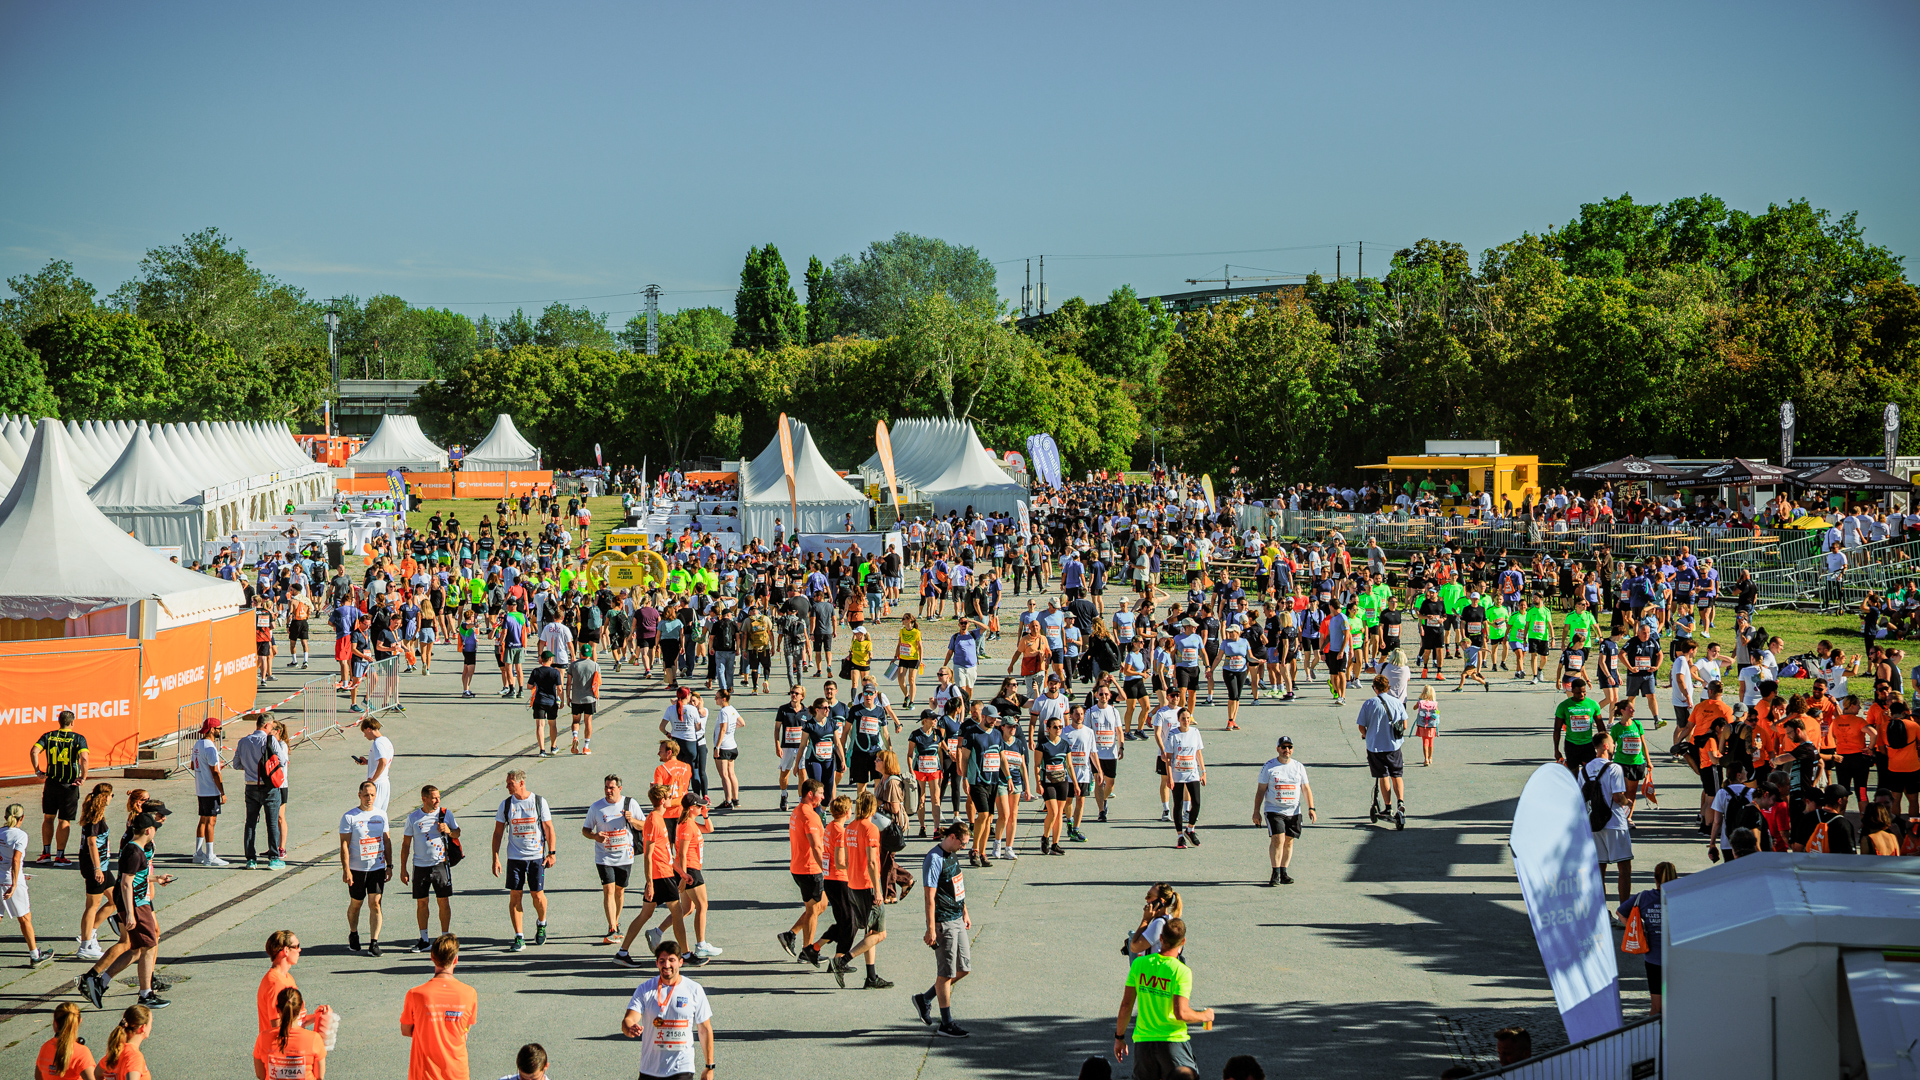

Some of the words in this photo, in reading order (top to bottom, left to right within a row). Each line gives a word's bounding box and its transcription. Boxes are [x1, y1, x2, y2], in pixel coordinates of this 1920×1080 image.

[609, 536, 644, 545] Ottakringer
[223, 660, 236, 677] WIEN
[236, 652, 257, 673] ENERGIE
[160, 673, 178, 692] WIEN
[177, 665, 205, 688] ENERGIE
[0, 706, 47, 725] WIEN
[50, 745, 70, 765] 14
